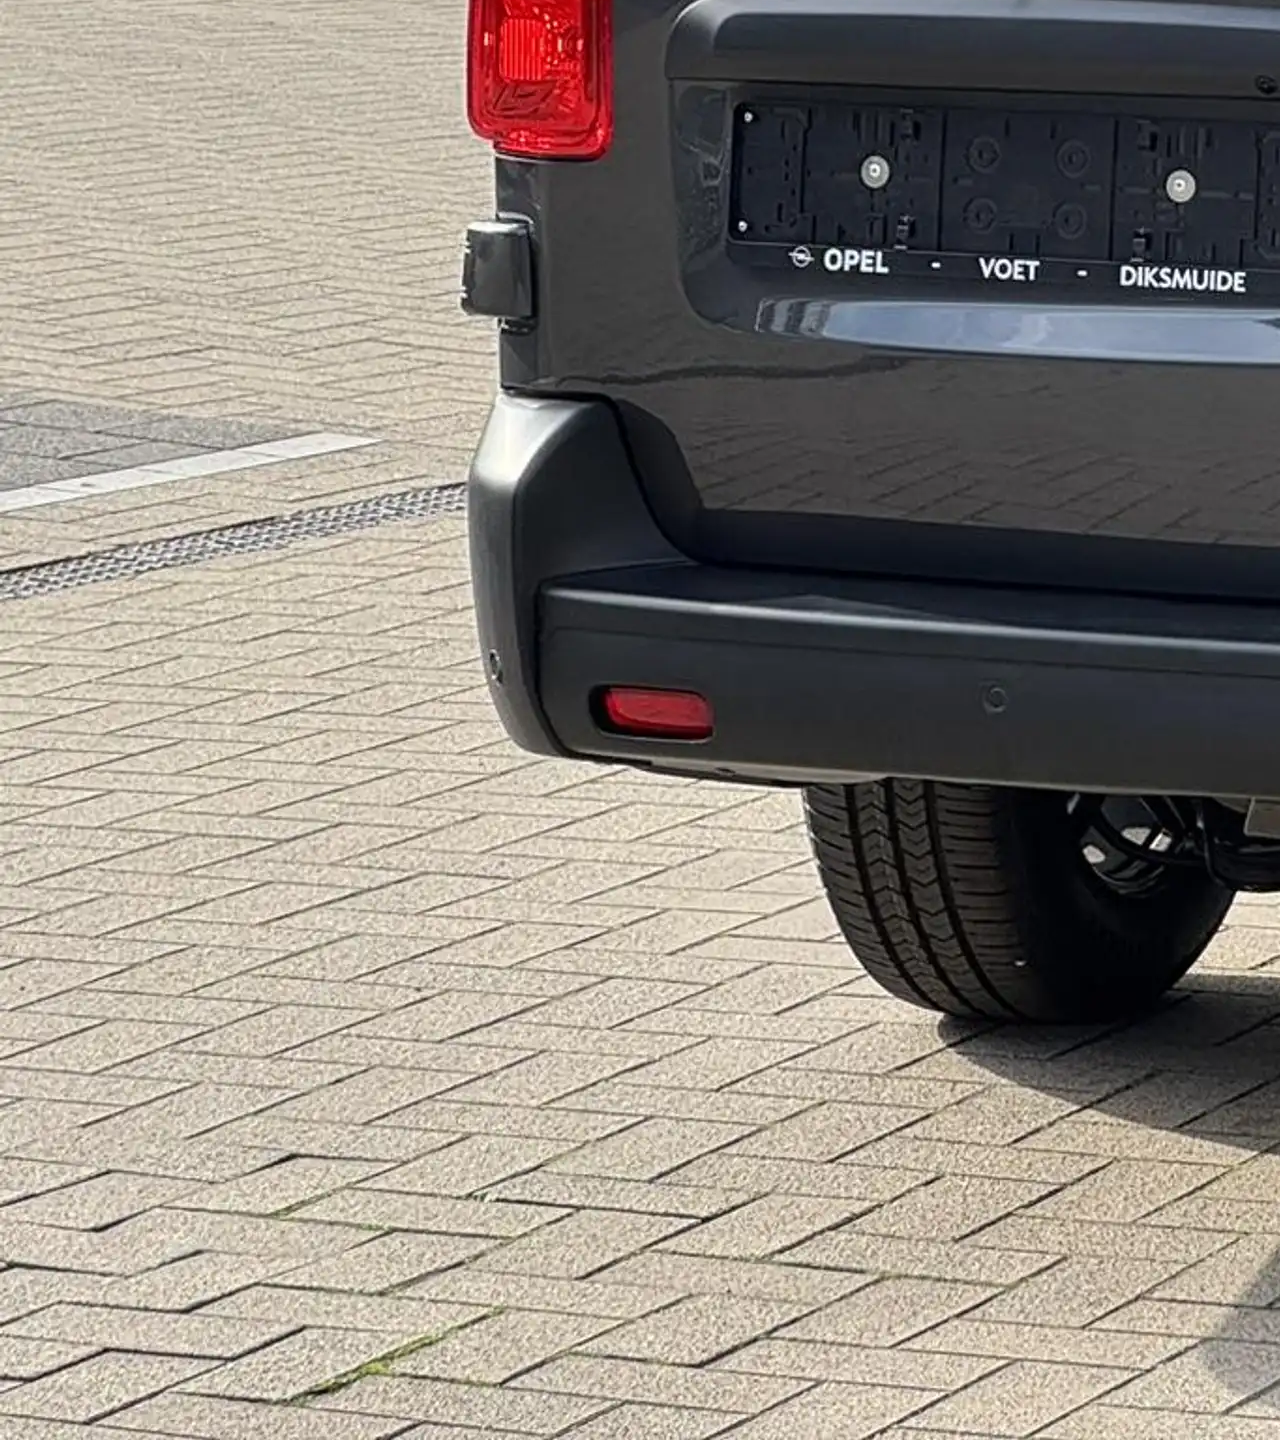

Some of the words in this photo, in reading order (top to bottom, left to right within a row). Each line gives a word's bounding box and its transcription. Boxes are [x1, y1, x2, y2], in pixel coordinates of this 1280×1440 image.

[823, 247, 890, 274] OPEL
[978, 256, 1041, 282] VOET
[1119, 264, 1248, 293] DIKSMUIDE
